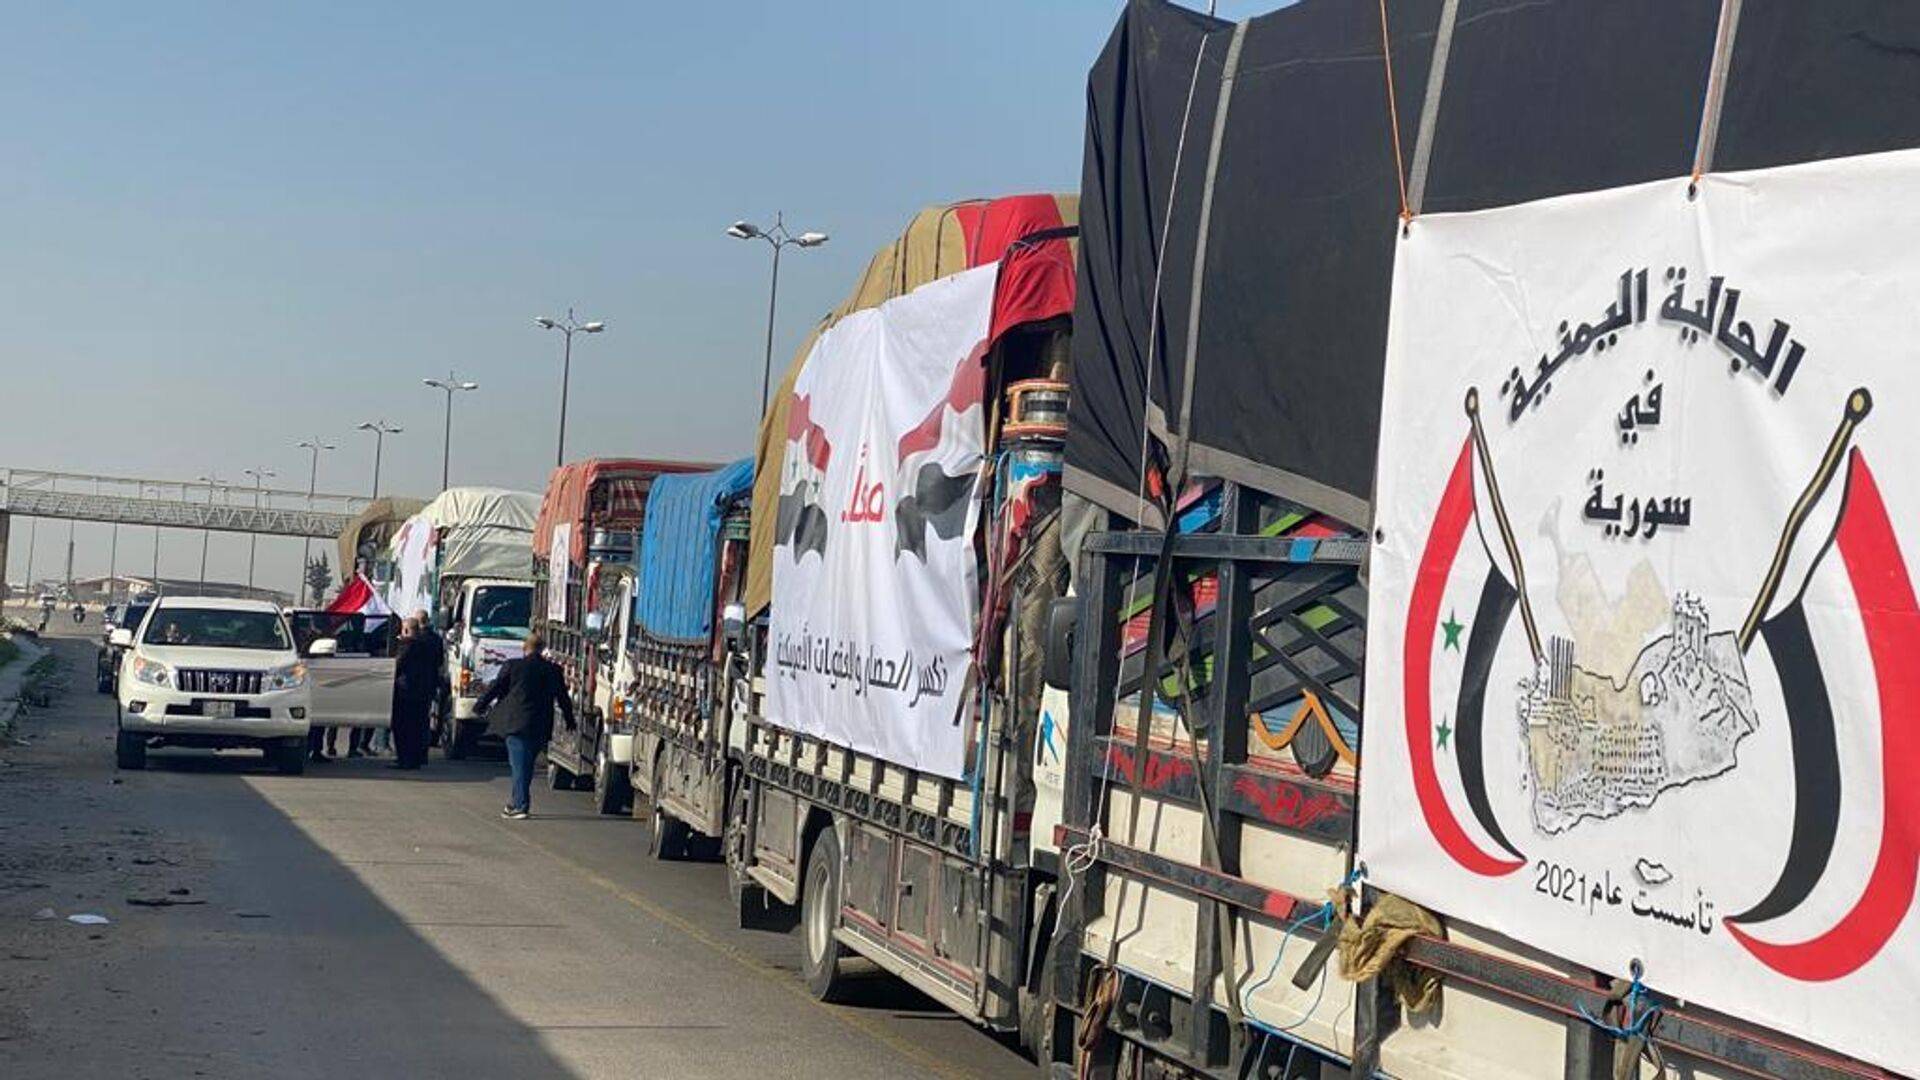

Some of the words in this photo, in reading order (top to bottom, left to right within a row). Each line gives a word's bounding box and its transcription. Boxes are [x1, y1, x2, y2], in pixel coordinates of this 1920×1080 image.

[1501, 267, 1648, 423] اليمنية
[1660, 266, 1806, 396] الجالية
[1617, 368, 1663, 445] في
[1584, 468, 1691, 539] سورية
[864, 644, 913, 699] الحصار
[1535, 859, 1587, 906] 2021
[1589, 869, 1623, 916] عام
[1631, 887, 1714, 935] تأسست
